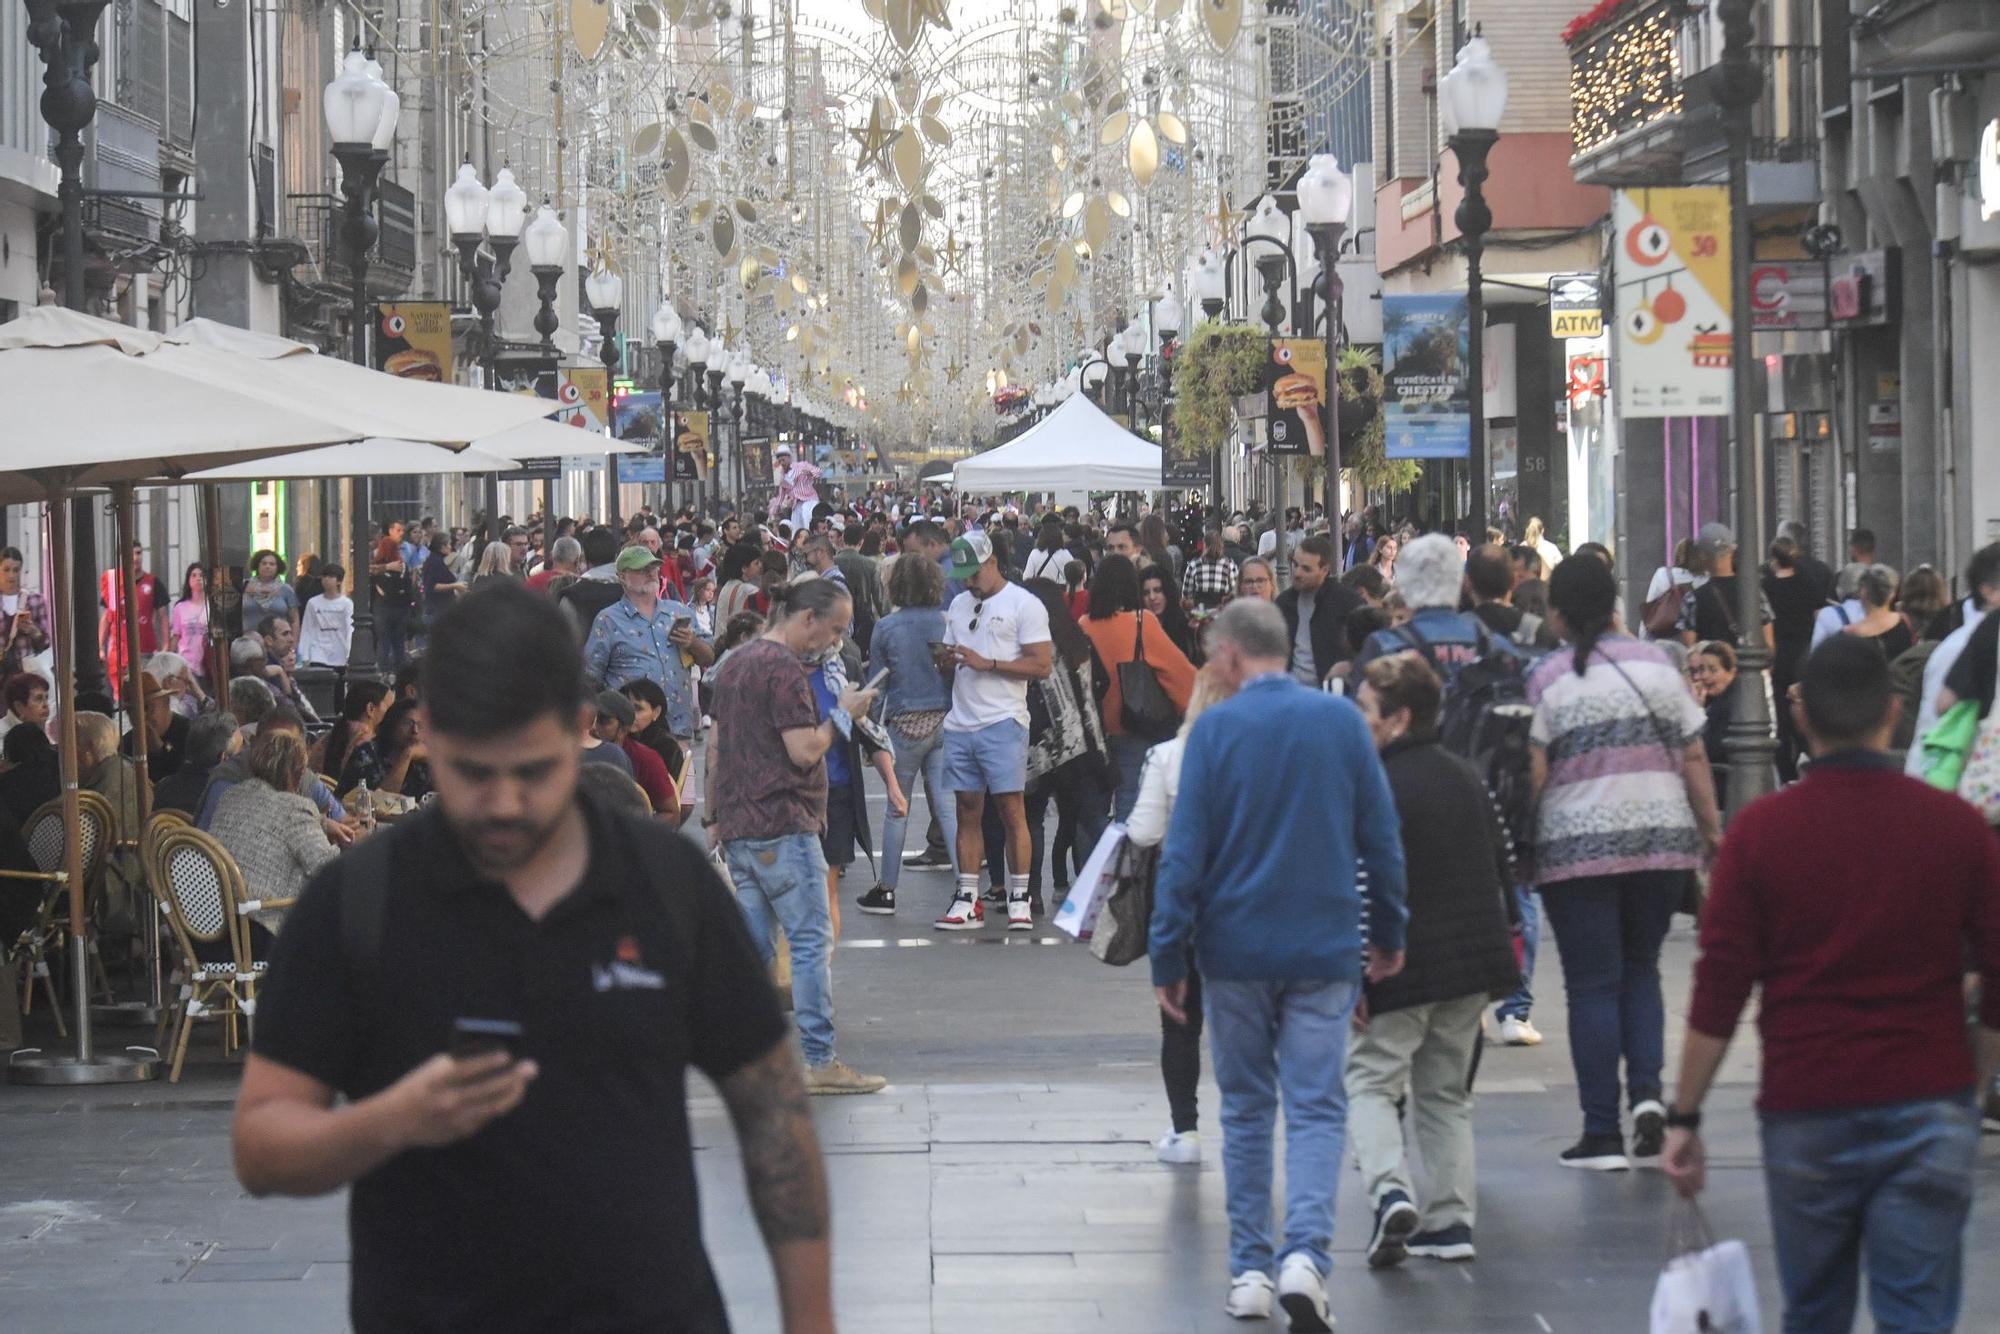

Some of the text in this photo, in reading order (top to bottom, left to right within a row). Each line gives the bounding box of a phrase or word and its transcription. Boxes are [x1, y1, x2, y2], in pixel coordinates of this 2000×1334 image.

[1690, 236, 1718, 256] 30
[1555, 316, 1599, 331] ATM
[1397, 385, 1455, 395] CHESTER
[1525, 456, 1546, 472] 58
